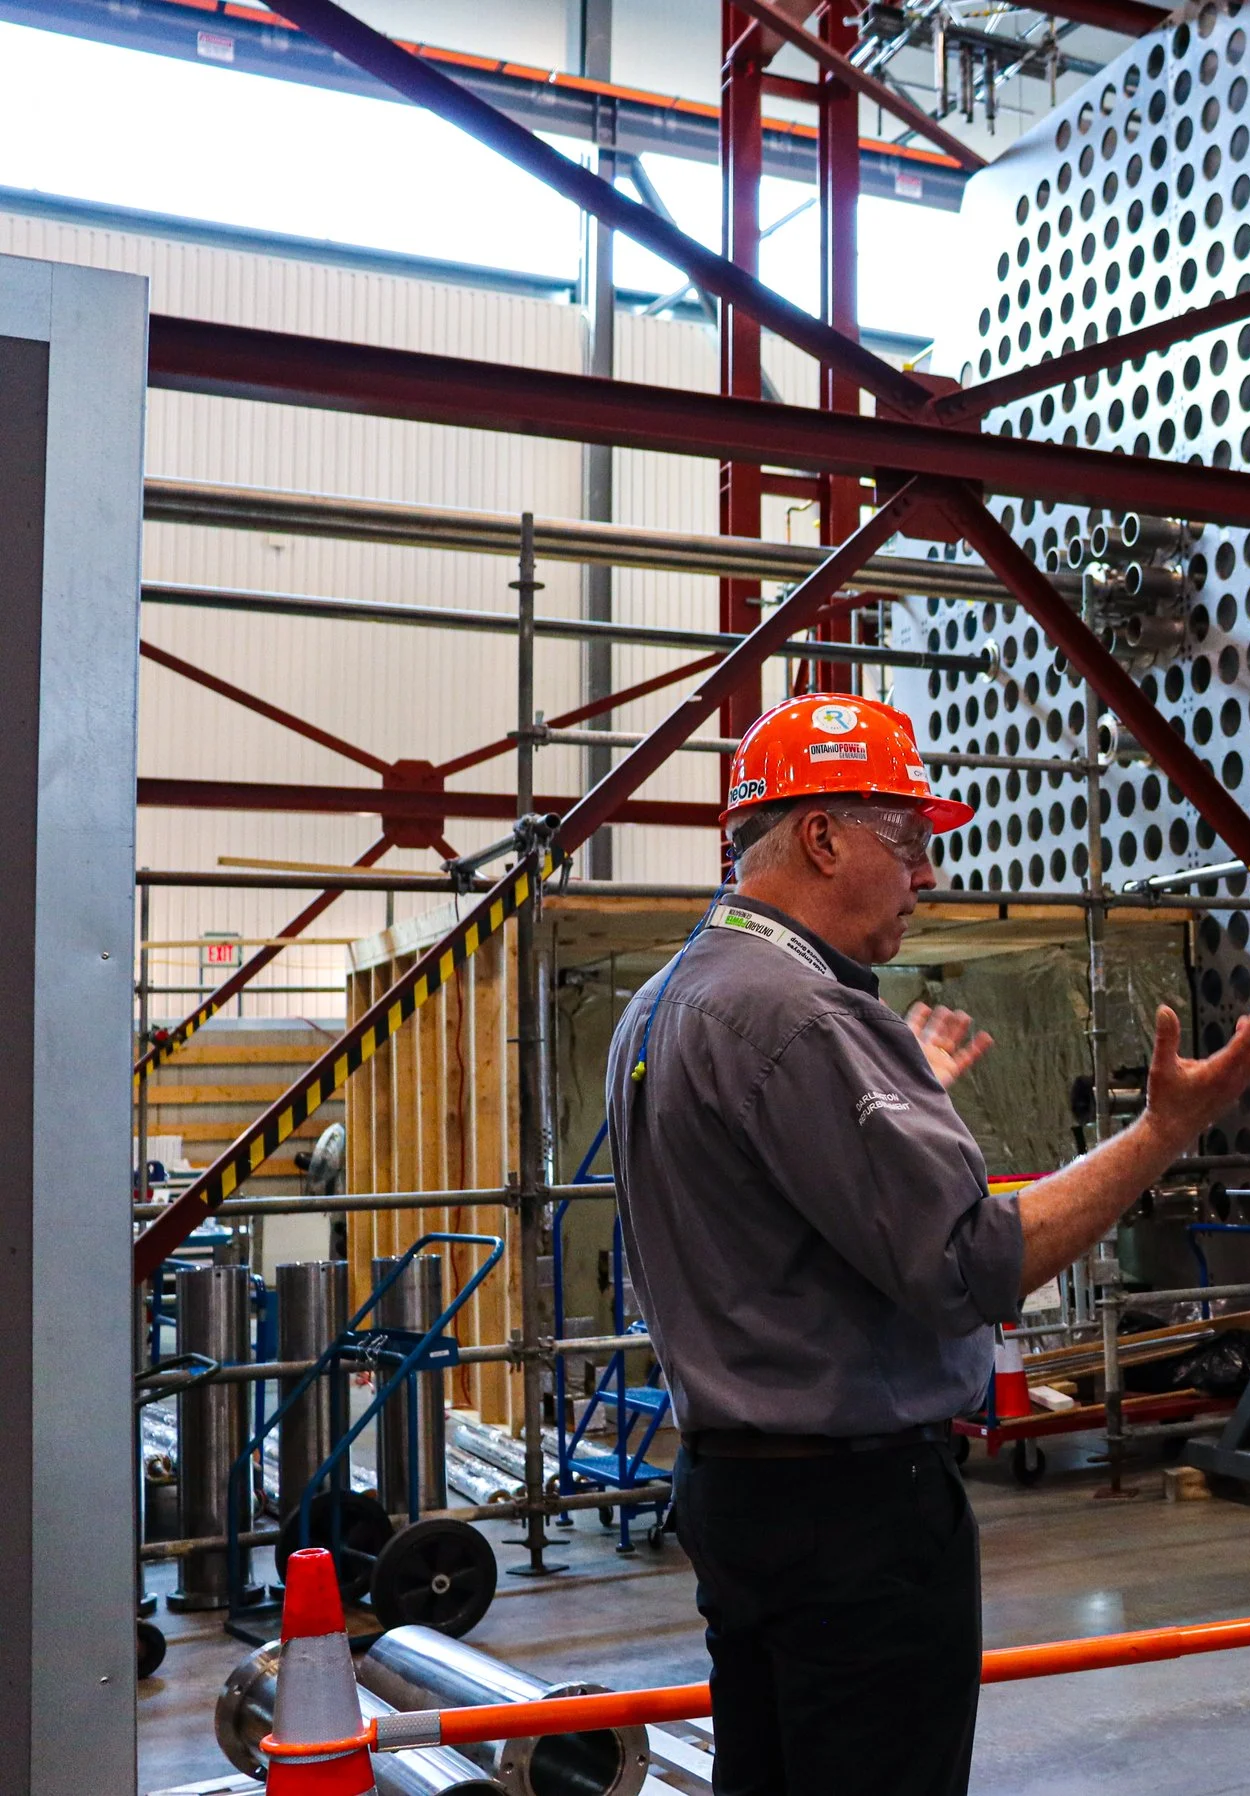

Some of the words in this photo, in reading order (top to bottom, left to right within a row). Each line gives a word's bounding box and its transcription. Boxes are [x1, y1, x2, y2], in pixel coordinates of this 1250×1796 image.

[207, 944, 234, 963] EXIT
[786, 942, 813, 964] Employee
[790, 937, 808, 952] Group
